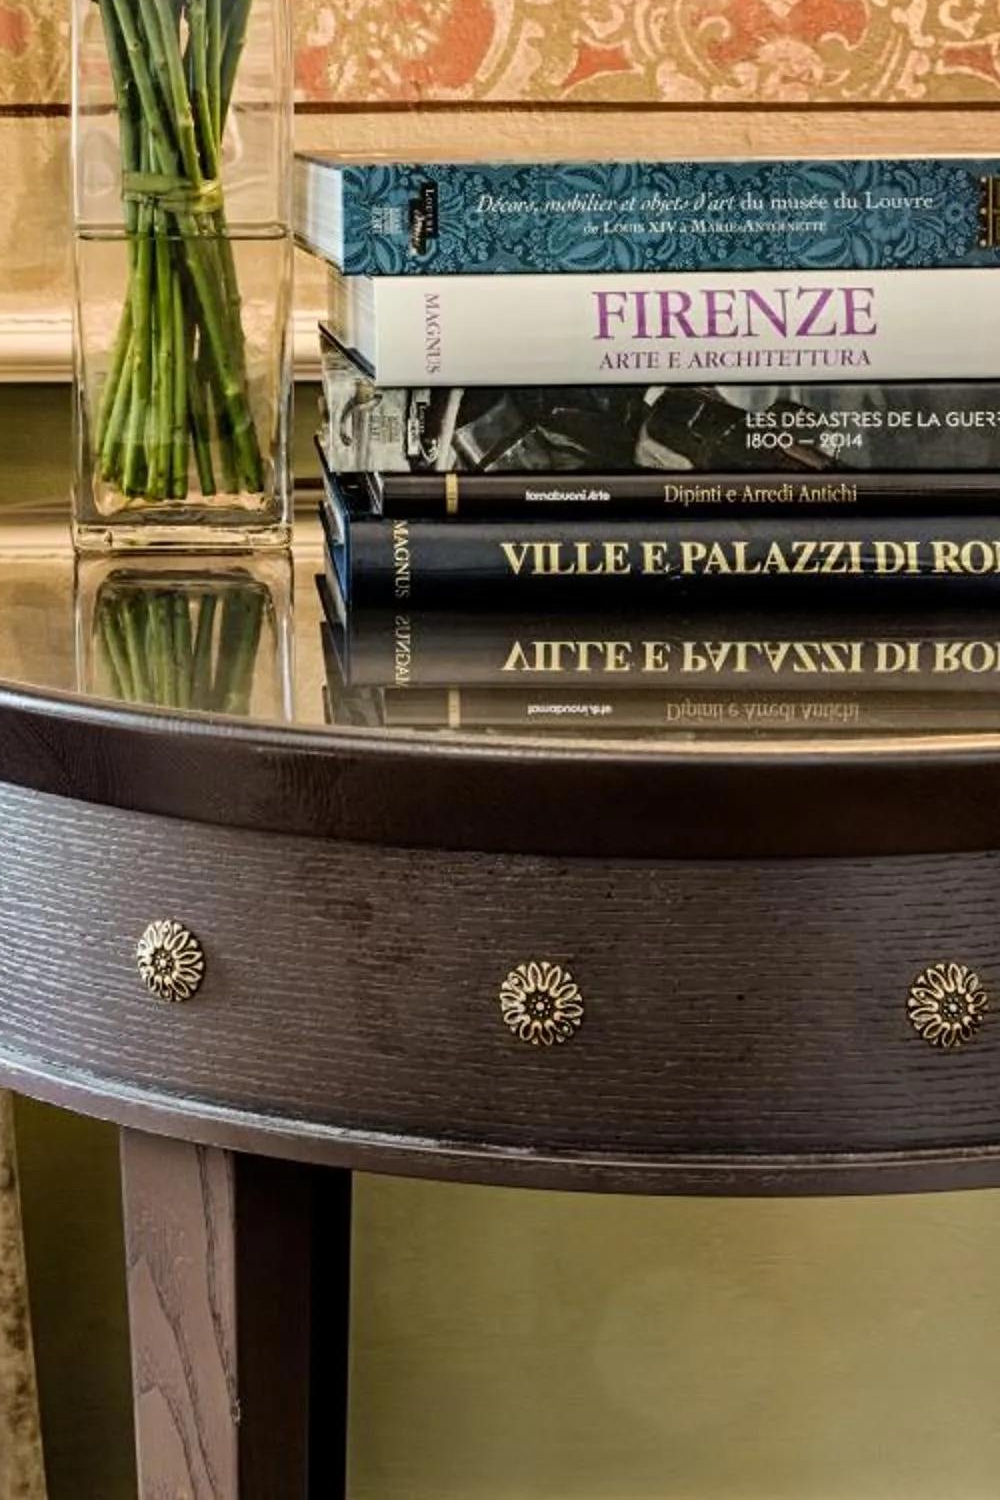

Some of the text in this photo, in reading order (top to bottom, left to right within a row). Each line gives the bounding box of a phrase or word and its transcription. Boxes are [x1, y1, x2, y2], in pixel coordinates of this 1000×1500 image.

[545, 192, 615, 211] mobilier
[620, 197, 636, 211] et
[641, 191, 689, 216] objets
[741, 192, 763, 210] du
[770, 193, 828, 210] musée
[833, 191, 857, 209] du
[866, 190, 934, 209] Louvre
[583, 221, 599, 235] de
[649, 220, 678, 234] XIV
[592, 286, 878, 340] FIRENZE
[425, 292, 440, 375] MAGNUS
[600, 349, 872, 370] ARTE E ARCHITETTURA
[745, 411, 777, 428] LES
[781, 407, 883, 428] DÉSASTRES
[888, 411, 913, 427] DE
[917, 411, 941, 427] LA
[746, 432, 793, 449] 1800
[820, 432, 863, 449] 2014
[664, 483, 857, 506] Dipinti e Arredi Antichi
[393, 519, 411, 598] MAGNUS
[500, 541, 1000, 575] VILLE E PALAZZI DI RO
